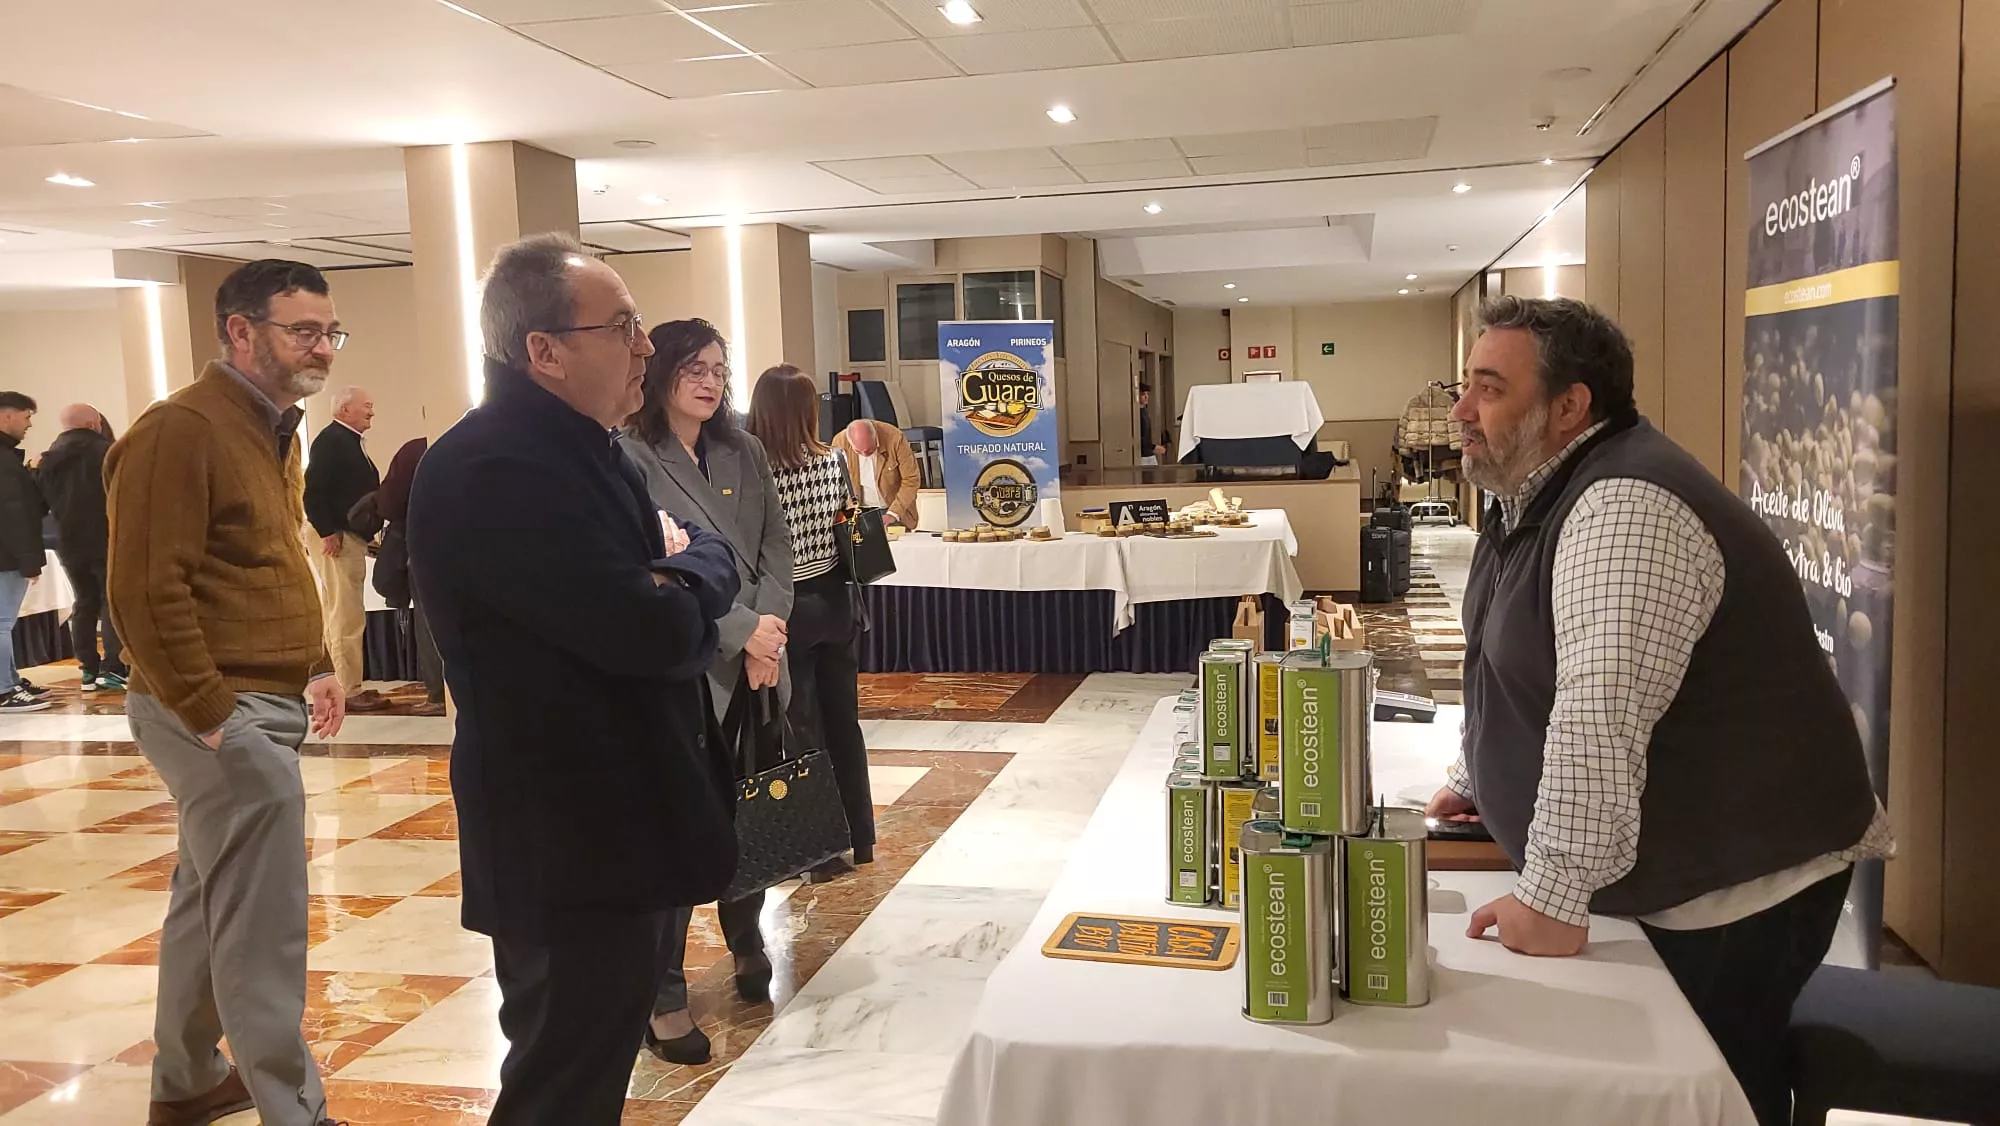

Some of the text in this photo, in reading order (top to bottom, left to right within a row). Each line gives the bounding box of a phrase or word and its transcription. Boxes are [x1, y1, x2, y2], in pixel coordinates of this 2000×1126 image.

[946, 337, 981, 348] ARAGÓN
[1010, 338, 1047, 347] PIRINEOS
[988, 371, 1034, 383] Quesos de
[962, 372, 1037, 405] Guara
[957, 442, 1047, 455] TRUFADO NATURAL
[1751, 480, 1845, 533] Aceite de Oliva
[1783, 539, 1820, 584] xtra
[1822, 551, 1832, 588] &
[1166, 925, 1216, 957] CASA
